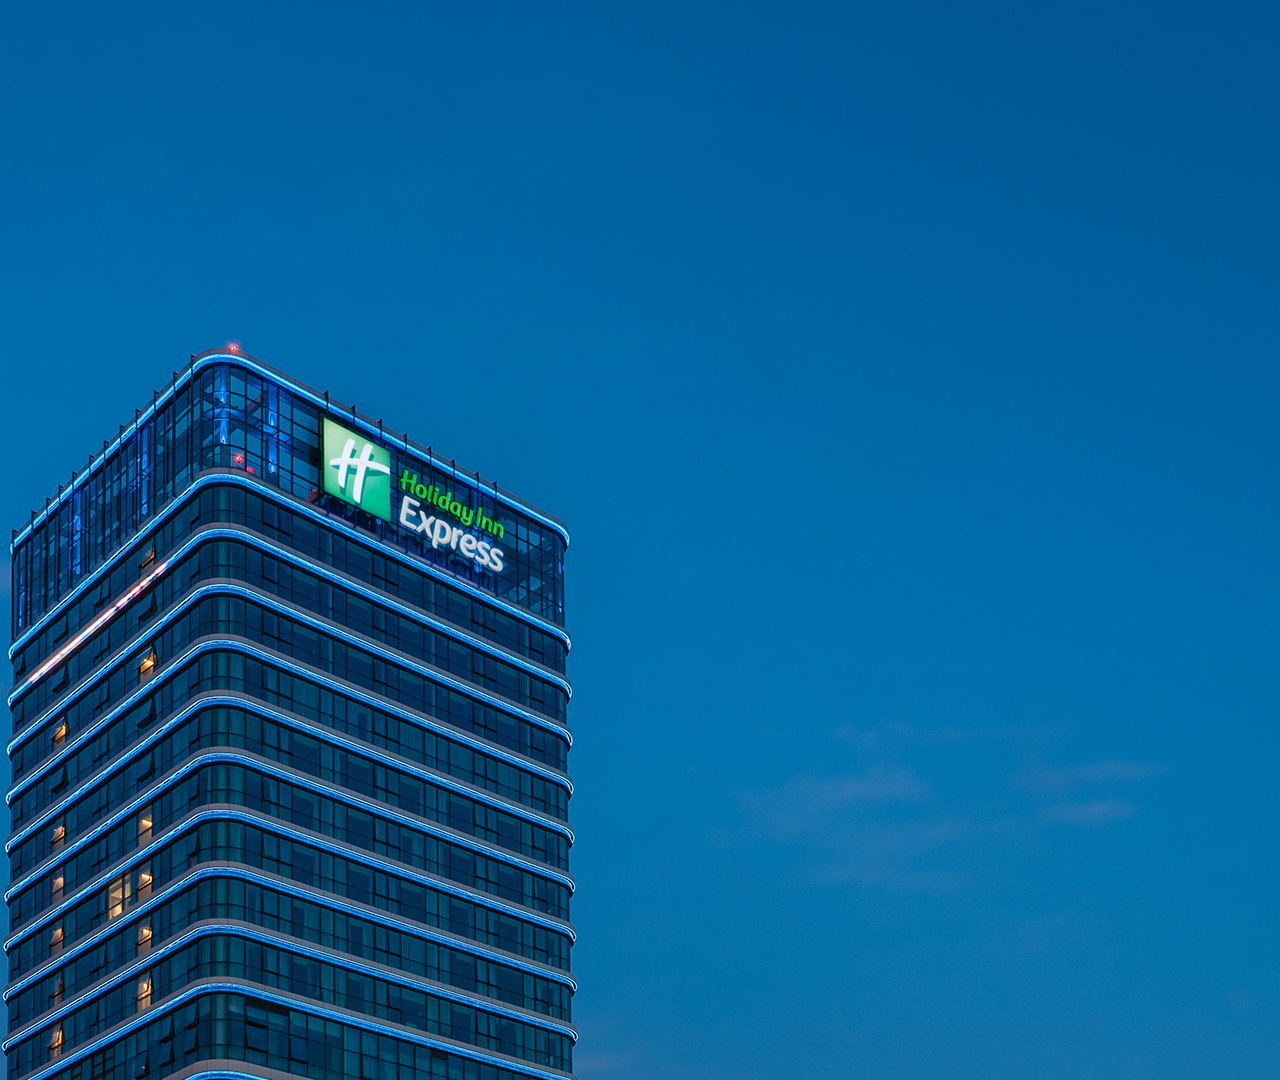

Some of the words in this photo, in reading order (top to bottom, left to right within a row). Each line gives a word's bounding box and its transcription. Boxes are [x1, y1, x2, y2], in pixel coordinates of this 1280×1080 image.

[399, 468, 474, 526] Holiday
[476, 507, 505, 539] Inn
[399, 495, 504, 572] Express
